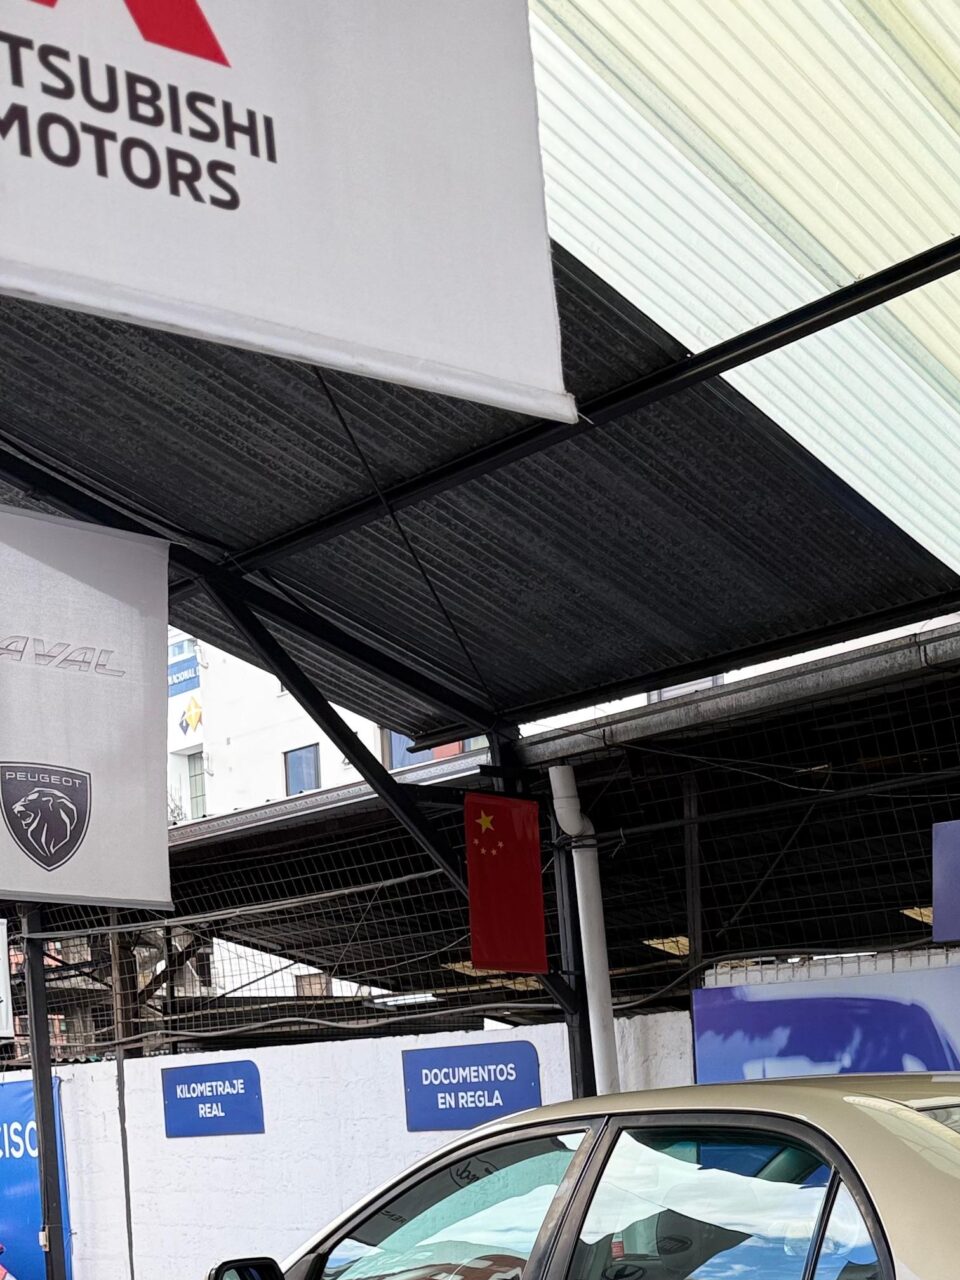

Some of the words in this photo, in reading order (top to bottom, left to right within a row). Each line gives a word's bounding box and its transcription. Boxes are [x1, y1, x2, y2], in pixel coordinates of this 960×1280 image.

[5, 771, 82, 788] PEUGEOT
[421, 1063, 517, 1085] DOCUMENTOS
[176, 1080, 245, 1099] KILOMETRAJE
[437, 1091, 456, 1109] EN
[458, 1089, 503, 1108] REGLA
[198, 1102, 226, 1118] REAL
